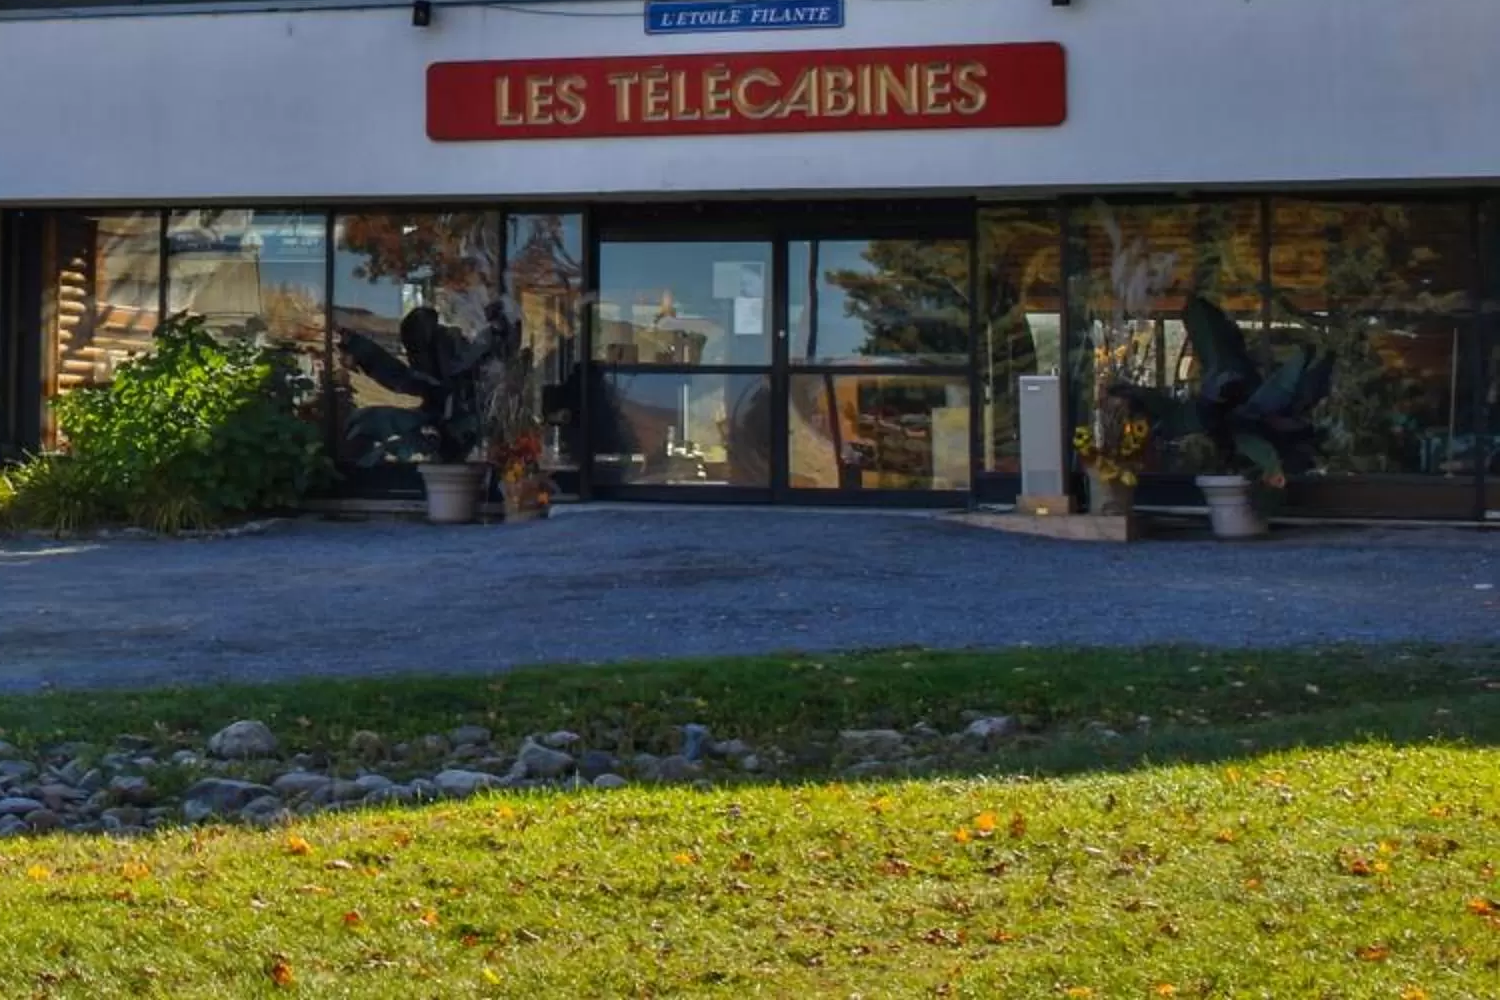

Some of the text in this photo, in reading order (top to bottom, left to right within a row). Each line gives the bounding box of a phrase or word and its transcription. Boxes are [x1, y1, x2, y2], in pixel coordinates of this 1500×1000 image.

[751, 6, 832, 23] FILANTE
[494, 61, 989, 126] LES TÉLÉCABINES
